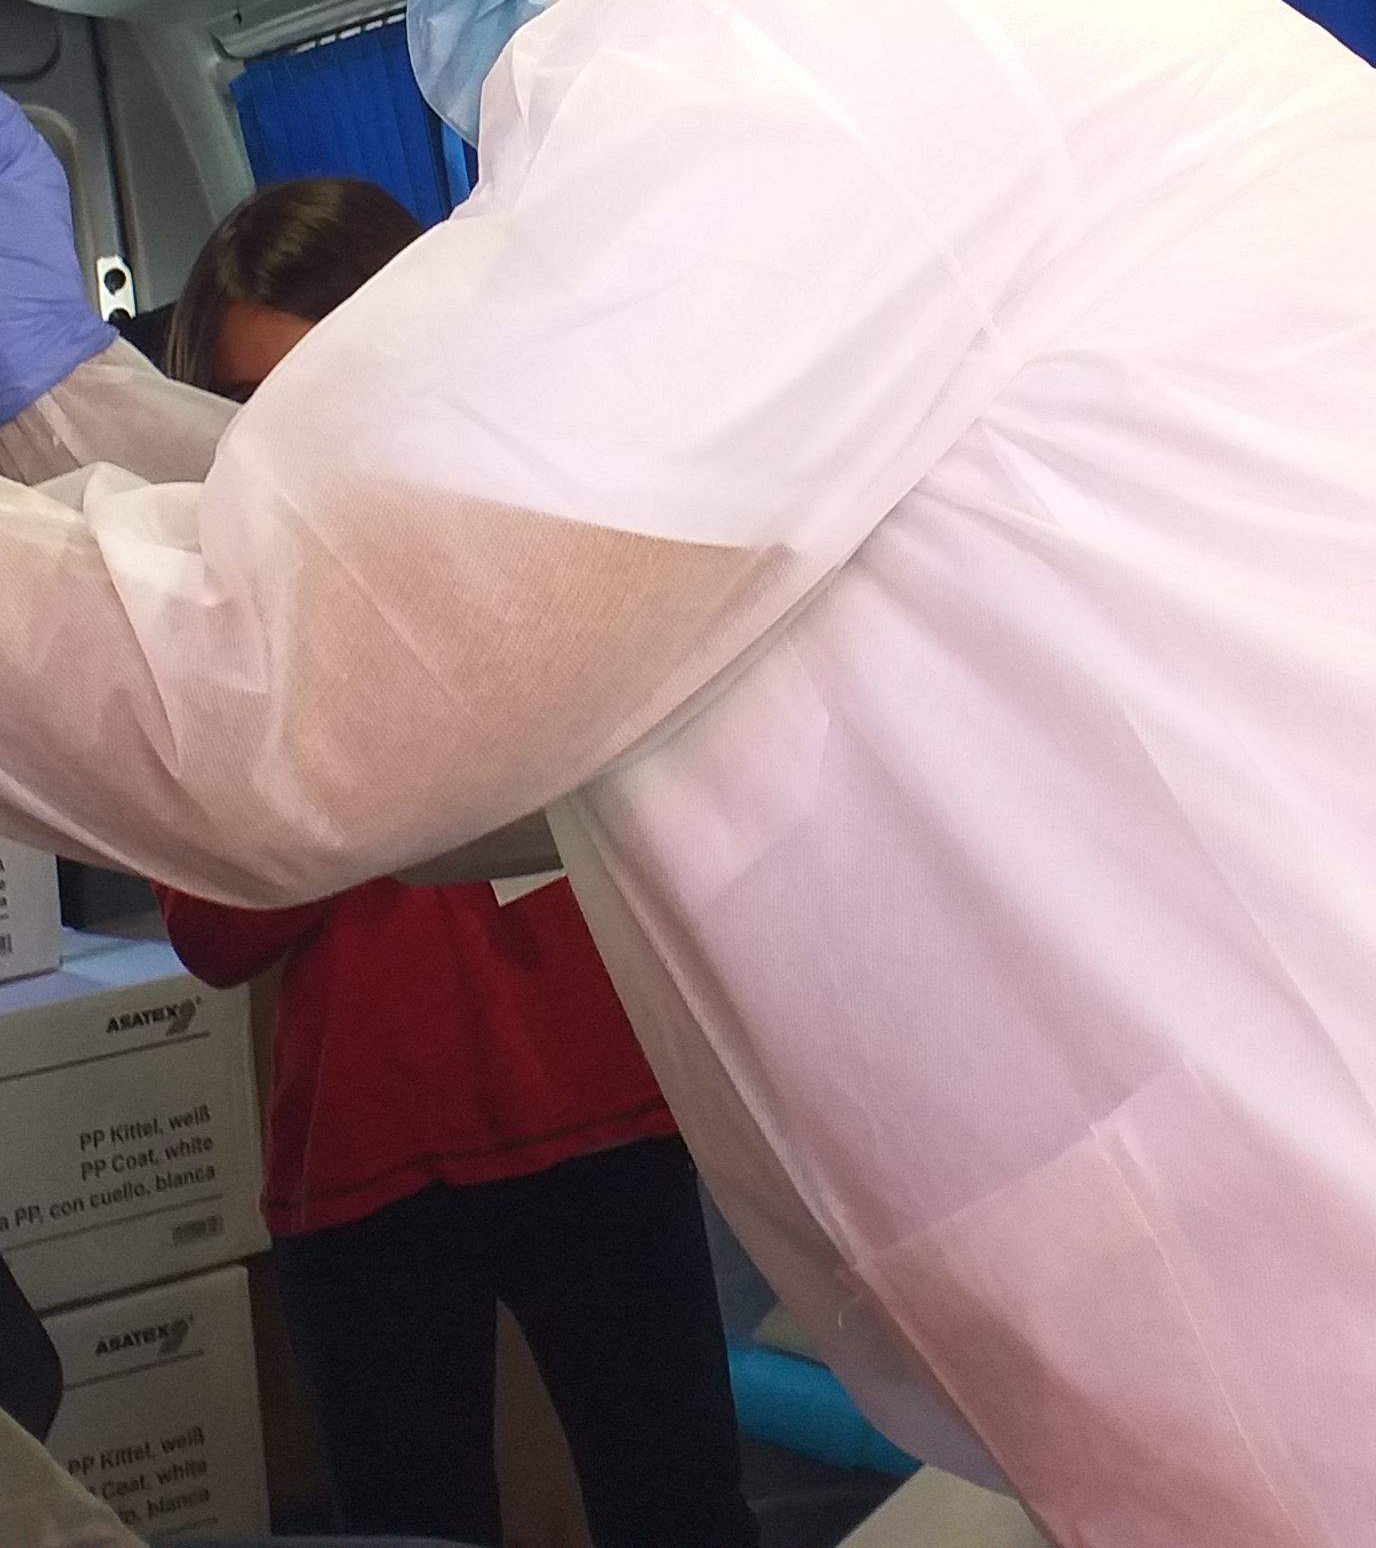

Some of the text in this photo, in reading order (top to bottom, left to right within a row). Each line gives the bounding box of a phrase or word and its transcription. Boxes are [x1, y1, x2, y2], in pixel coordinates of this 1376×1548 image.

[79, 1104, 211, 1152] PP Kittel, weiß
[81, 1135, 213, 1181] PP Coat, white
[49, 1196, 85, 1220] con
[89, 1181, 152, 1209] cuello,
[155, 1165, 216, 1192] blanca
[67, 1454, 94, 1476] PP
[161, 1426, 206, 1454] weiß
[156, 1459, 208, 1484] white
[146, 1488, 211, 1519] blanca
